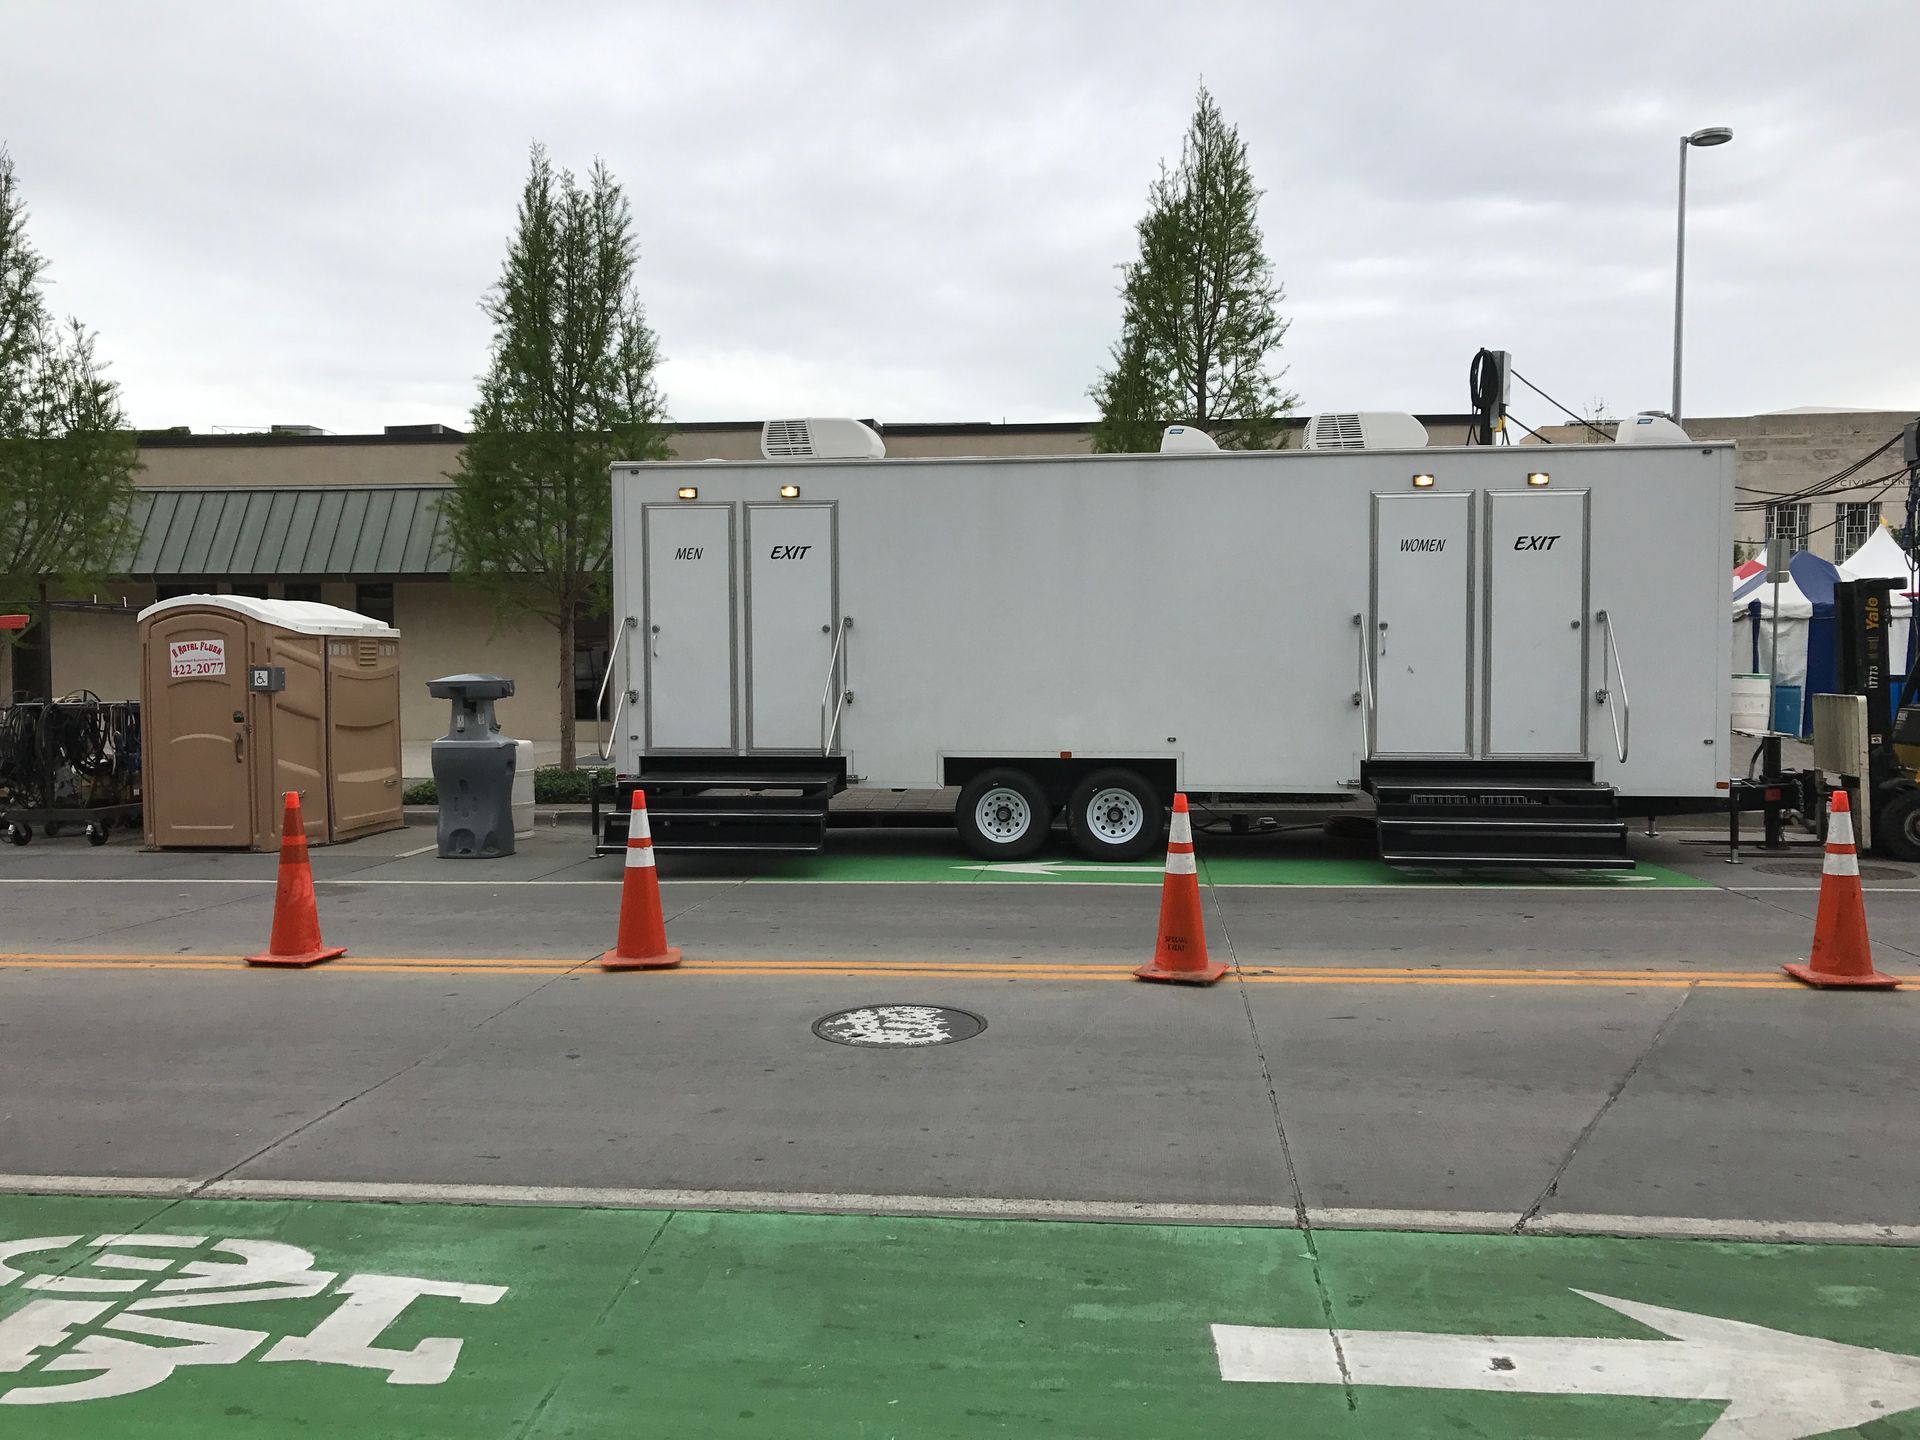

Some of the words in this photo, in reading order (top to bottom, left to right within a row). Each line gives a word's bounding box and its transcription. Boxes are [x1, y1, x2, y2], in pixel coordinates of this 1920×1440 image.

[1400, 538, 1446, 552] WOMEN
[1513, 535, 1560, 551] EXIT
[675, 547, 703, 560] MEN
[770, 545, 811, 560] EXIT
[1865, 597, 1880, 631] Yale
[177, 643, 199, 655] ROYAL
[200, 642, 222, 655] FLUSH
[172, 662, 224, 676] 422-2077
